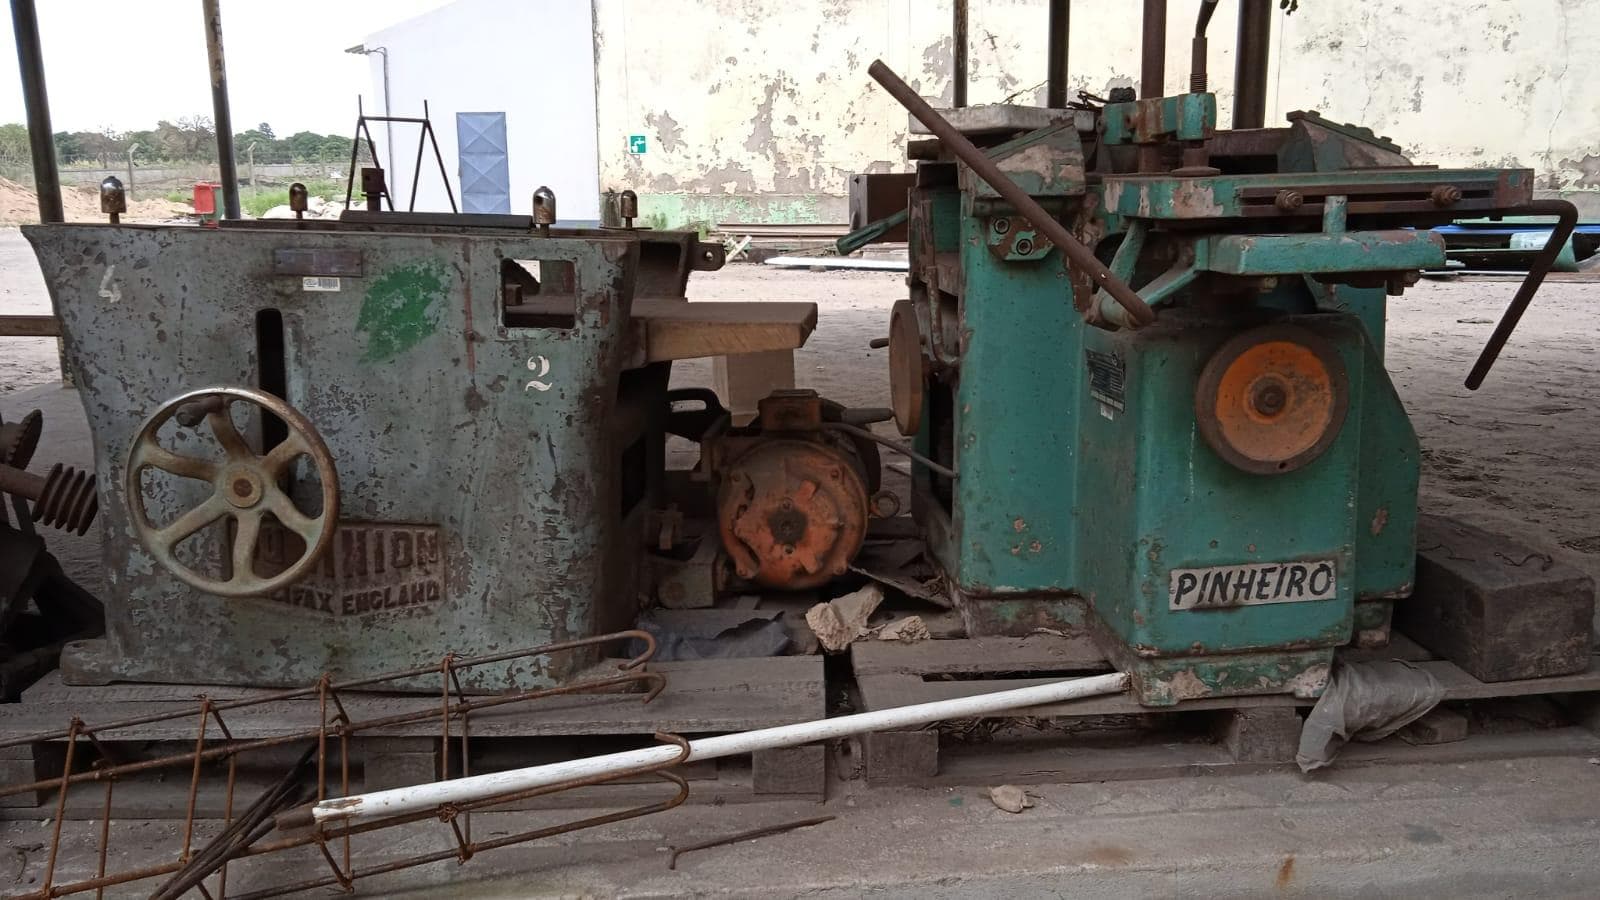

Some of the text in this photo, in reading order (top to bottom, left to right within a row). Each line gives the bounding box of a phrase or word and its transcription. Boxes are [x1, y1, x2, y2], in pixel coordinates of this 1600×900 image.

[525, 355, 553, 392] 2
[341, 580, 437, 615] ENGLAND
[1174, 563, 1333, 606] PINHEIRO
